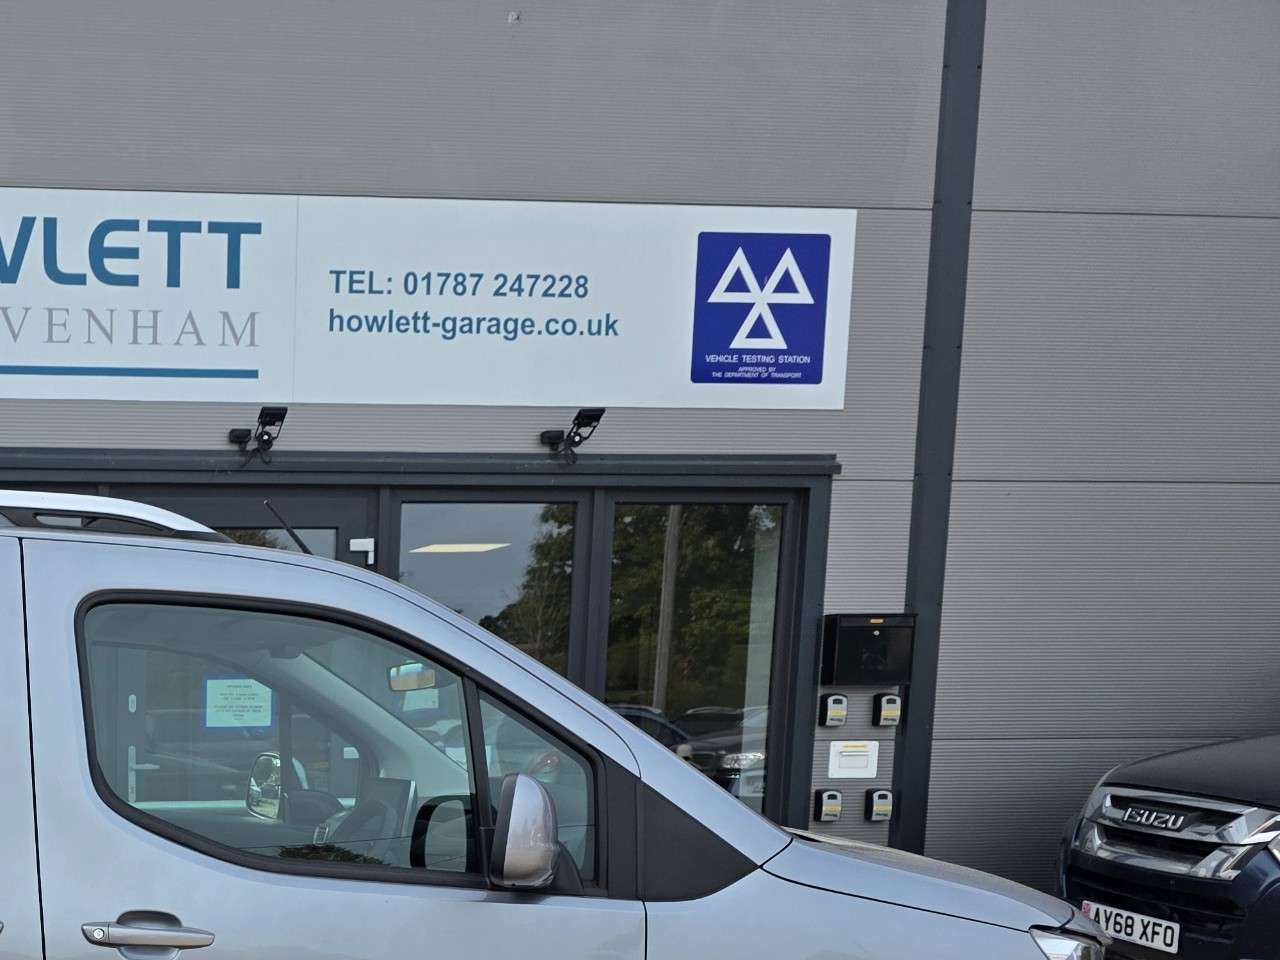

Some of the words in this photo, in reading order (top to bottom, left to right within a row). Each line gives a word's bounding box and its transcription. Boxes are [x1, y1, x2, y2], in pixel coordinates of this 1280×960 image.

[329, 270, 393, 295] TEL:
[403, 271, 484, 296] 01787
[492, 273, 589, 298] 247228
[328, 308, 619, 341] howlett-garage.co.uk
[705, 354, 738, 363] VEHICLE
[742, 355, 776, 364] TESTING
[778, 355, 811, 364] STATION
[1123, 807, 1185, 830] ISUZU
[1093, 907, 1135, 937] AY68
[1139, 918, 1175, 948] XFO
